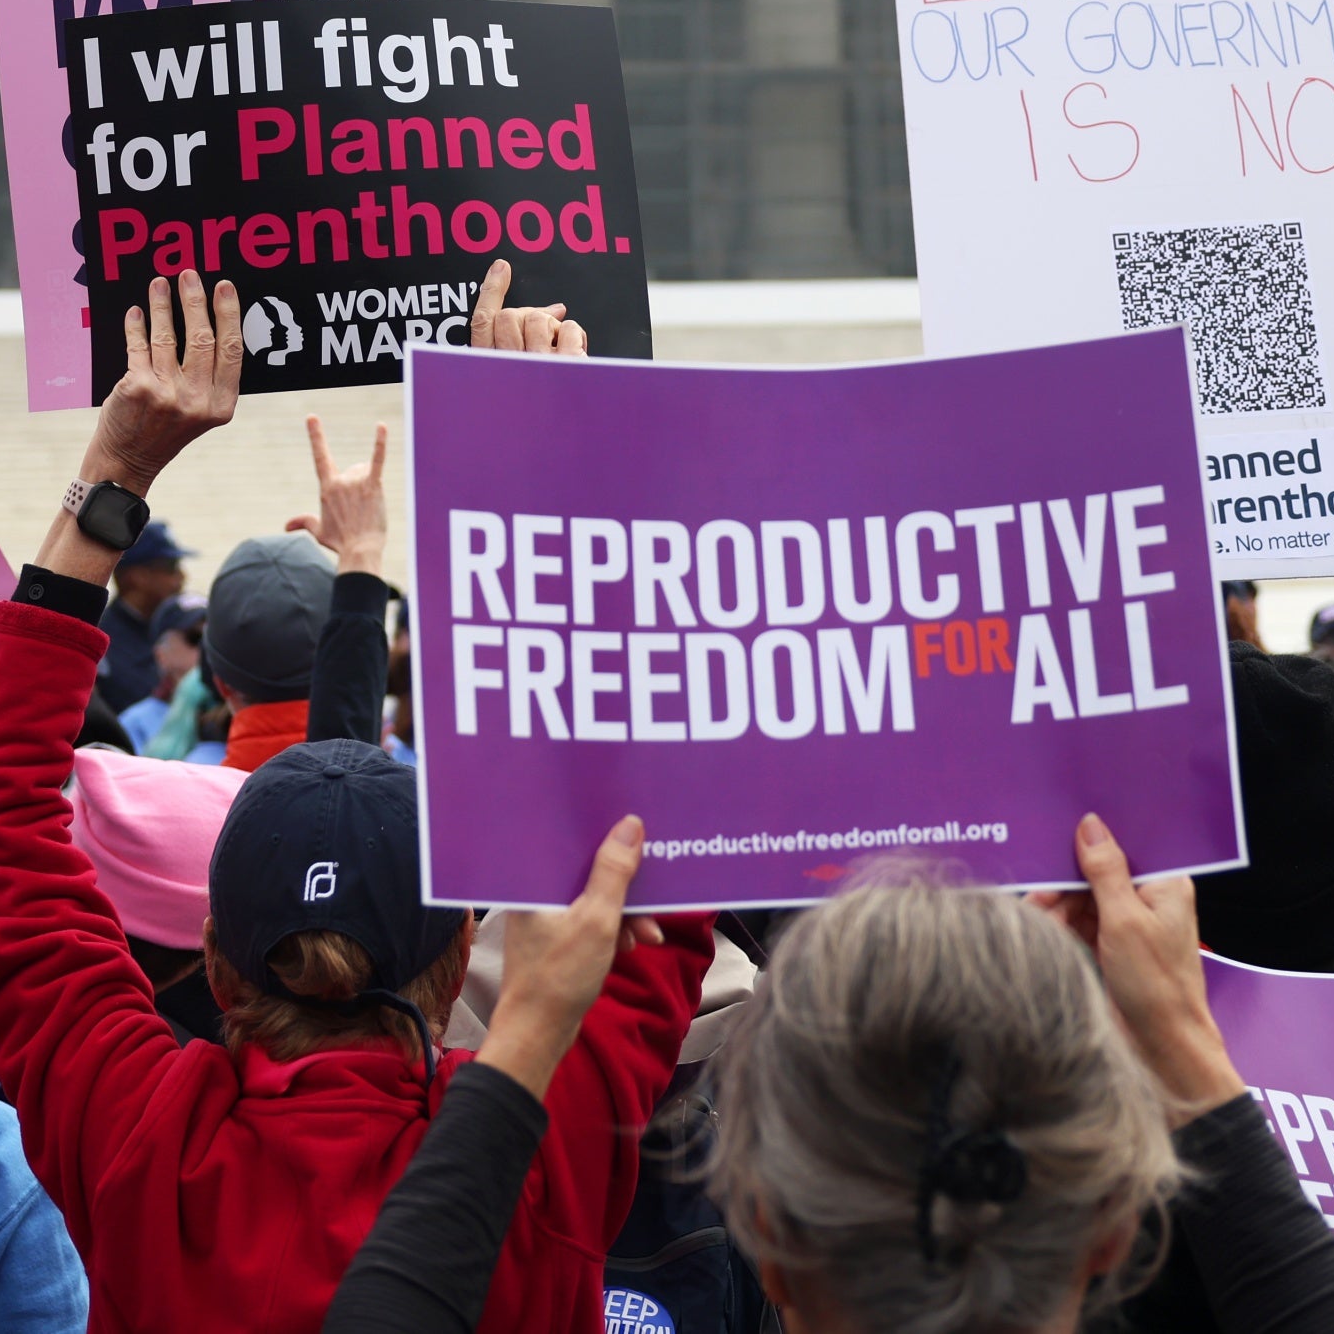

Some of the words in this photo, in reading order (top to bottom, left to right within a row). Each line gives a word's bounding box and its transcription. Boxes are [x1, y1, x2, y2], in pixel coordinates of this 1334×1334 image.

[83, 37, 104, 108] I
[131, 20, 283, 102] will
[315, 18, 518, 103] fight
[911, 5, 1035, 83] OUR
[86, 122, 207, 195] for
[237, 103, 597, 181] Planned
[1020, 82, 1139, 182] IS
[98, 184, 632, 281] Parenthood.
[316, 281, 481, 323] WOMEN'
[321, 315, 469, 366] MARC
[1206, 438, 1322, 482] anned
[448, 484, 1176, 630] REPRODUCTIVE
[1235, 534, 1264, 553] No
[1268, 532, 1331, 551] matter
[451, 623, 917, 743] FREEDOM
[912, 617, 1016, 679] FOR
[1010, 601, 1190, 726] ALL
[642, 820, 1009, 861] reproductivefreedomforall.org
[603, 1289, 659, 1322] EEP
